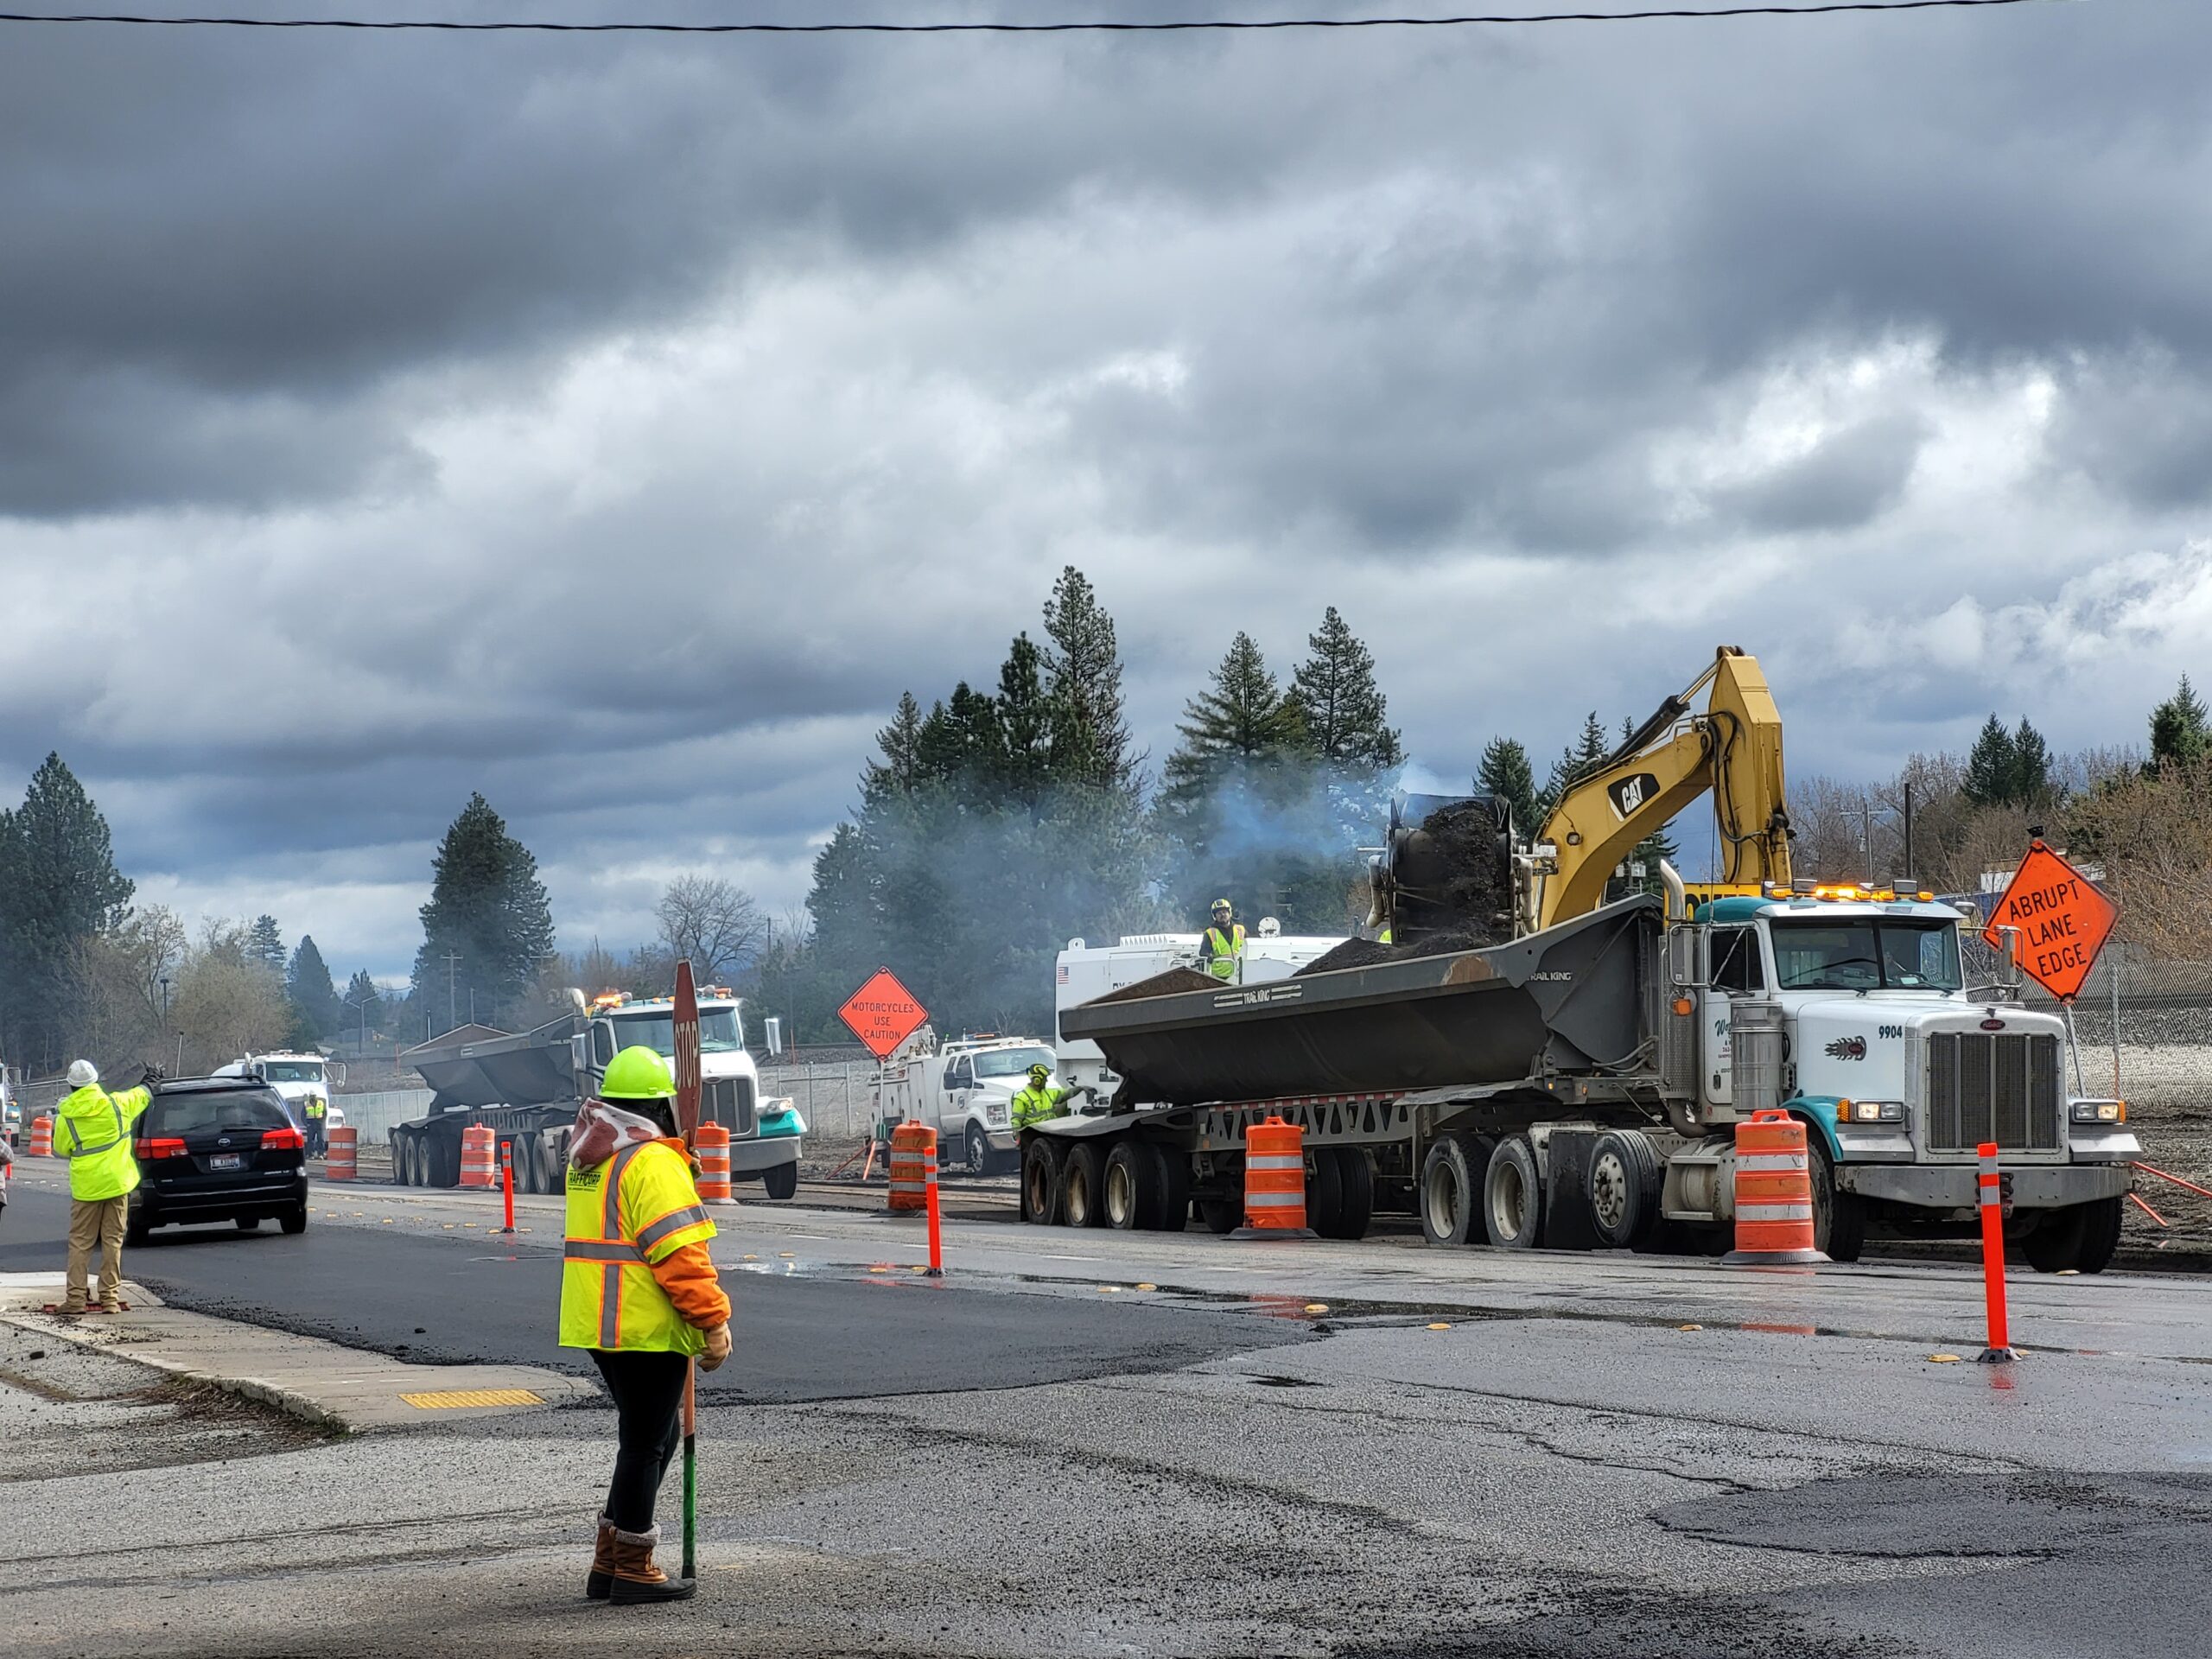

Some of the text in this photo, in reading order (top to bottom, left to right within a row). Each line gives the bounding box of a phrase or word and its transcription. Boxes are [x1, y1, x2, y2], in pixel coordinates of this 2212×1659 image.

[1622, 775, 1643, 813] CAT
[2009, 879, 2079, 922] ABRUPT
[2027, 913, 2077, 947] LANE
[2037, 943, 2087, 977] EDGE
[1550, 971, 1572, 982] KING
[1257, 988, 1271, 1003] KING
[851, 1002, 914, 1014] MOTORCYCLES
[874, 1016, 891, 1027] USE
[864, 1028, 900, 1040] CAUTION
[1878, 1025, 1903, 1039] 9904
[675, 1020, 698, 1090] STOP
